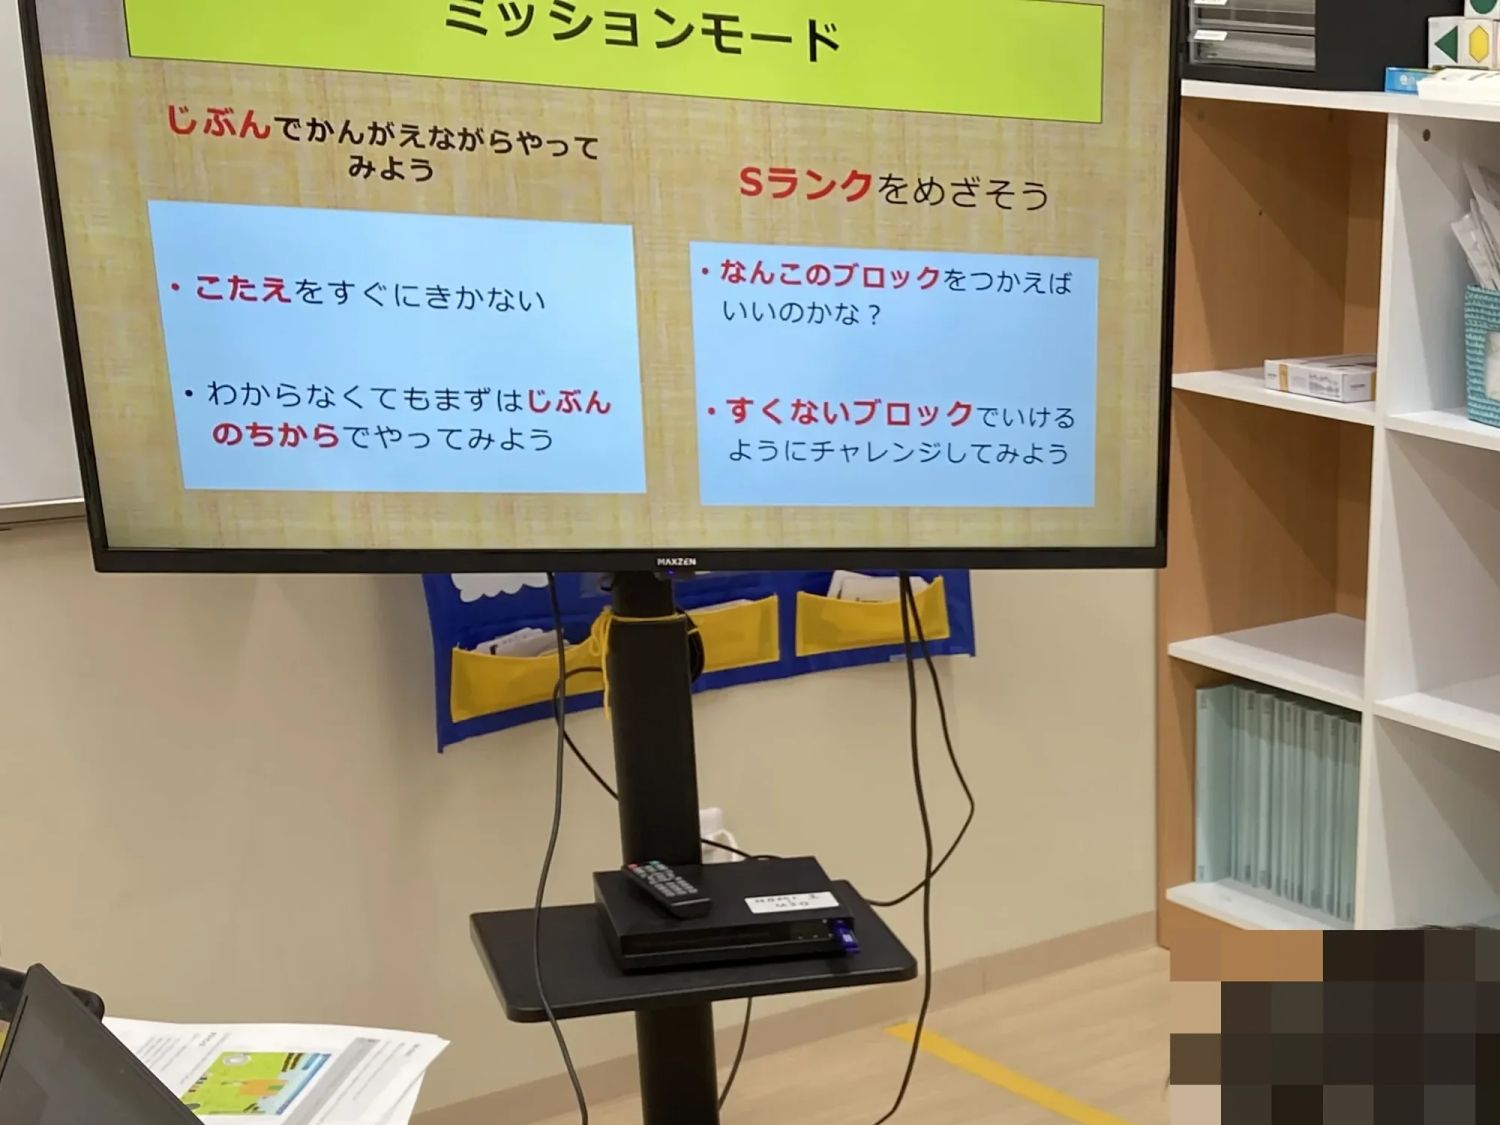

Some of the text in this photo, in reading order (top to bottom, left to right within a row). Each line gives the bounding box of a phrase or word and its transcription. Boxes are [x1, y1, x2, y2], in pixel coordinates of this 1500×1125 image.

[446, 0, 839, 62] ミッションモード
[167, 105, 599, 160] じぶんでかんがえながらやって
[348, 155, 434, 182] みよう
[739, 166, 1048, 211] Sランクをめざそう
[212, 422, 554, 452] のちからでやってみよう
[729, 438, 1069, 465] ようにチャレンジしてみよう
[657, 557, 697, 566] MAXZEN
